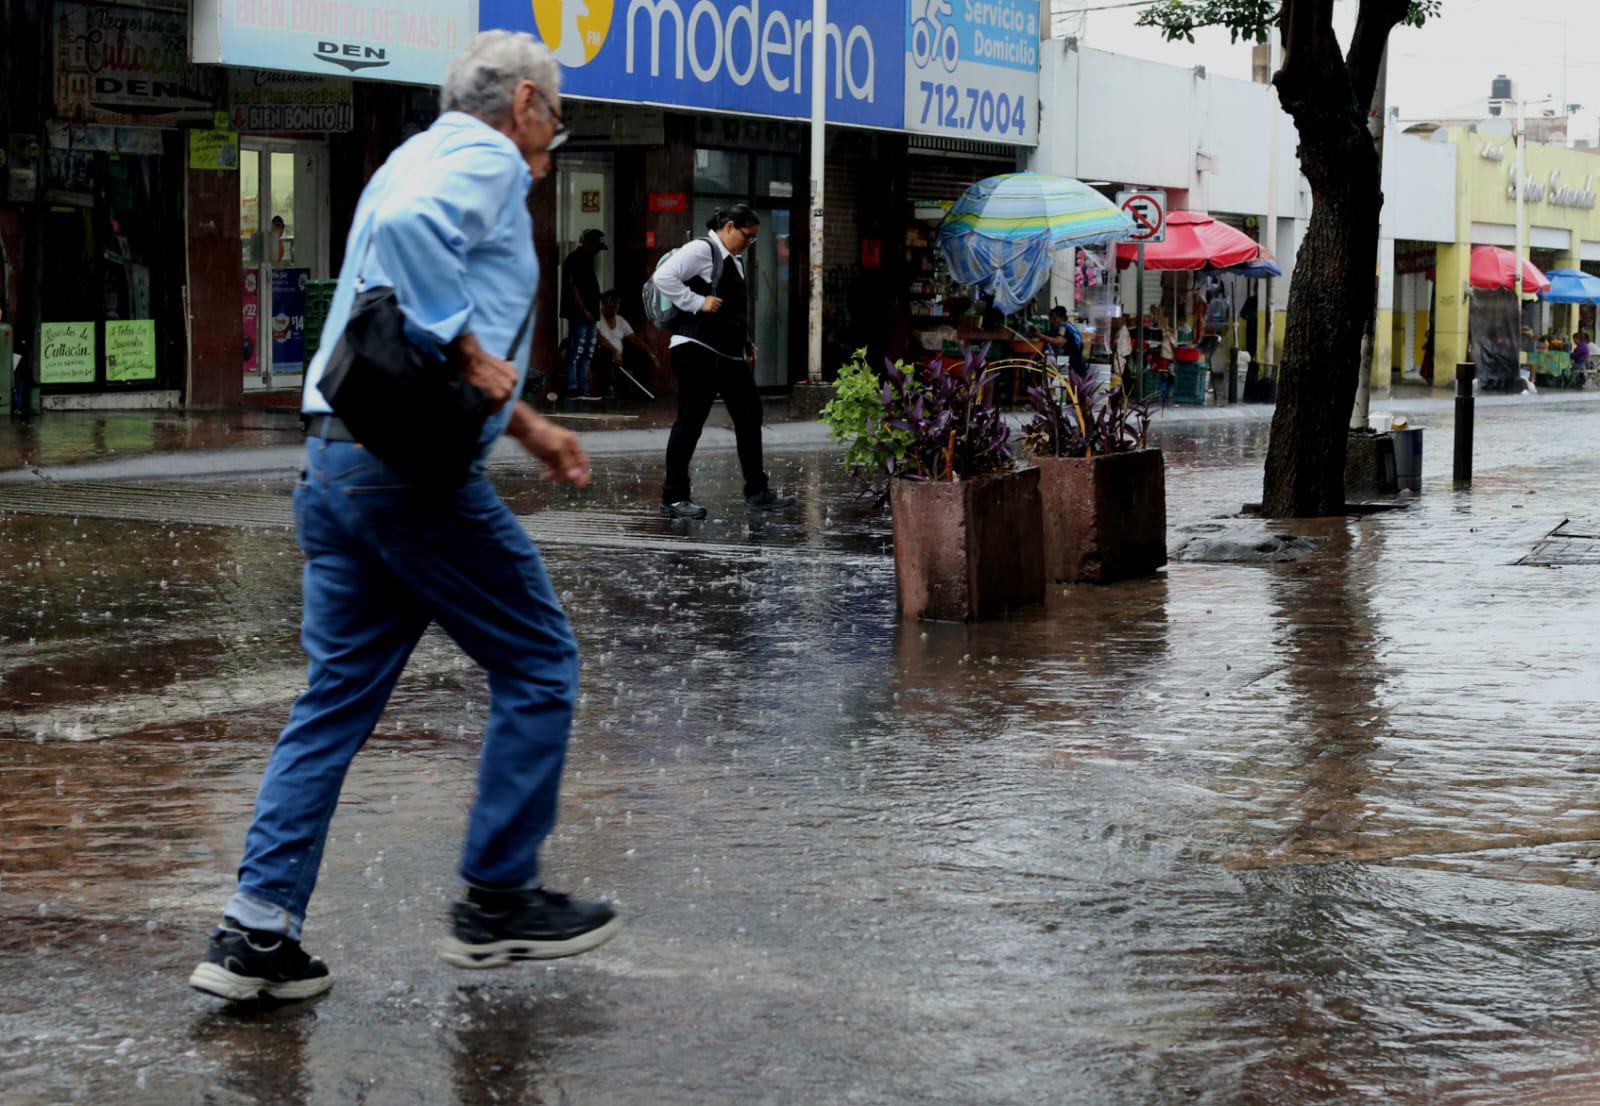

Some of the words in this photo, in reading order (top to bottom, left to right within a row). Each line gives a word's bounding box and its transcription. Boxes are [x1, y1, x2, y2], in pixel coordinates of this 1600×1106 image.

[236, 0, 285, 29] BIEN
[291, 0, 364, 38] BONITO
[370, 8, 395, 43] DE
[400, 8, 440, 48] MÁS
[964, 0, 1024, 32] Servicio
[1026, 13, 1036, 35] a
[317, 41, 385, 59] DEN
[626, 0, 874, 103] moderna
[974, 30, 1035, 65] Domicilio
[95, 78, 177, 97] DEN
[249, 105, 281, 129] BIEN
[284, 105, 337, 129] BONITO
[920, 80, 1025, 136] 712.7004
